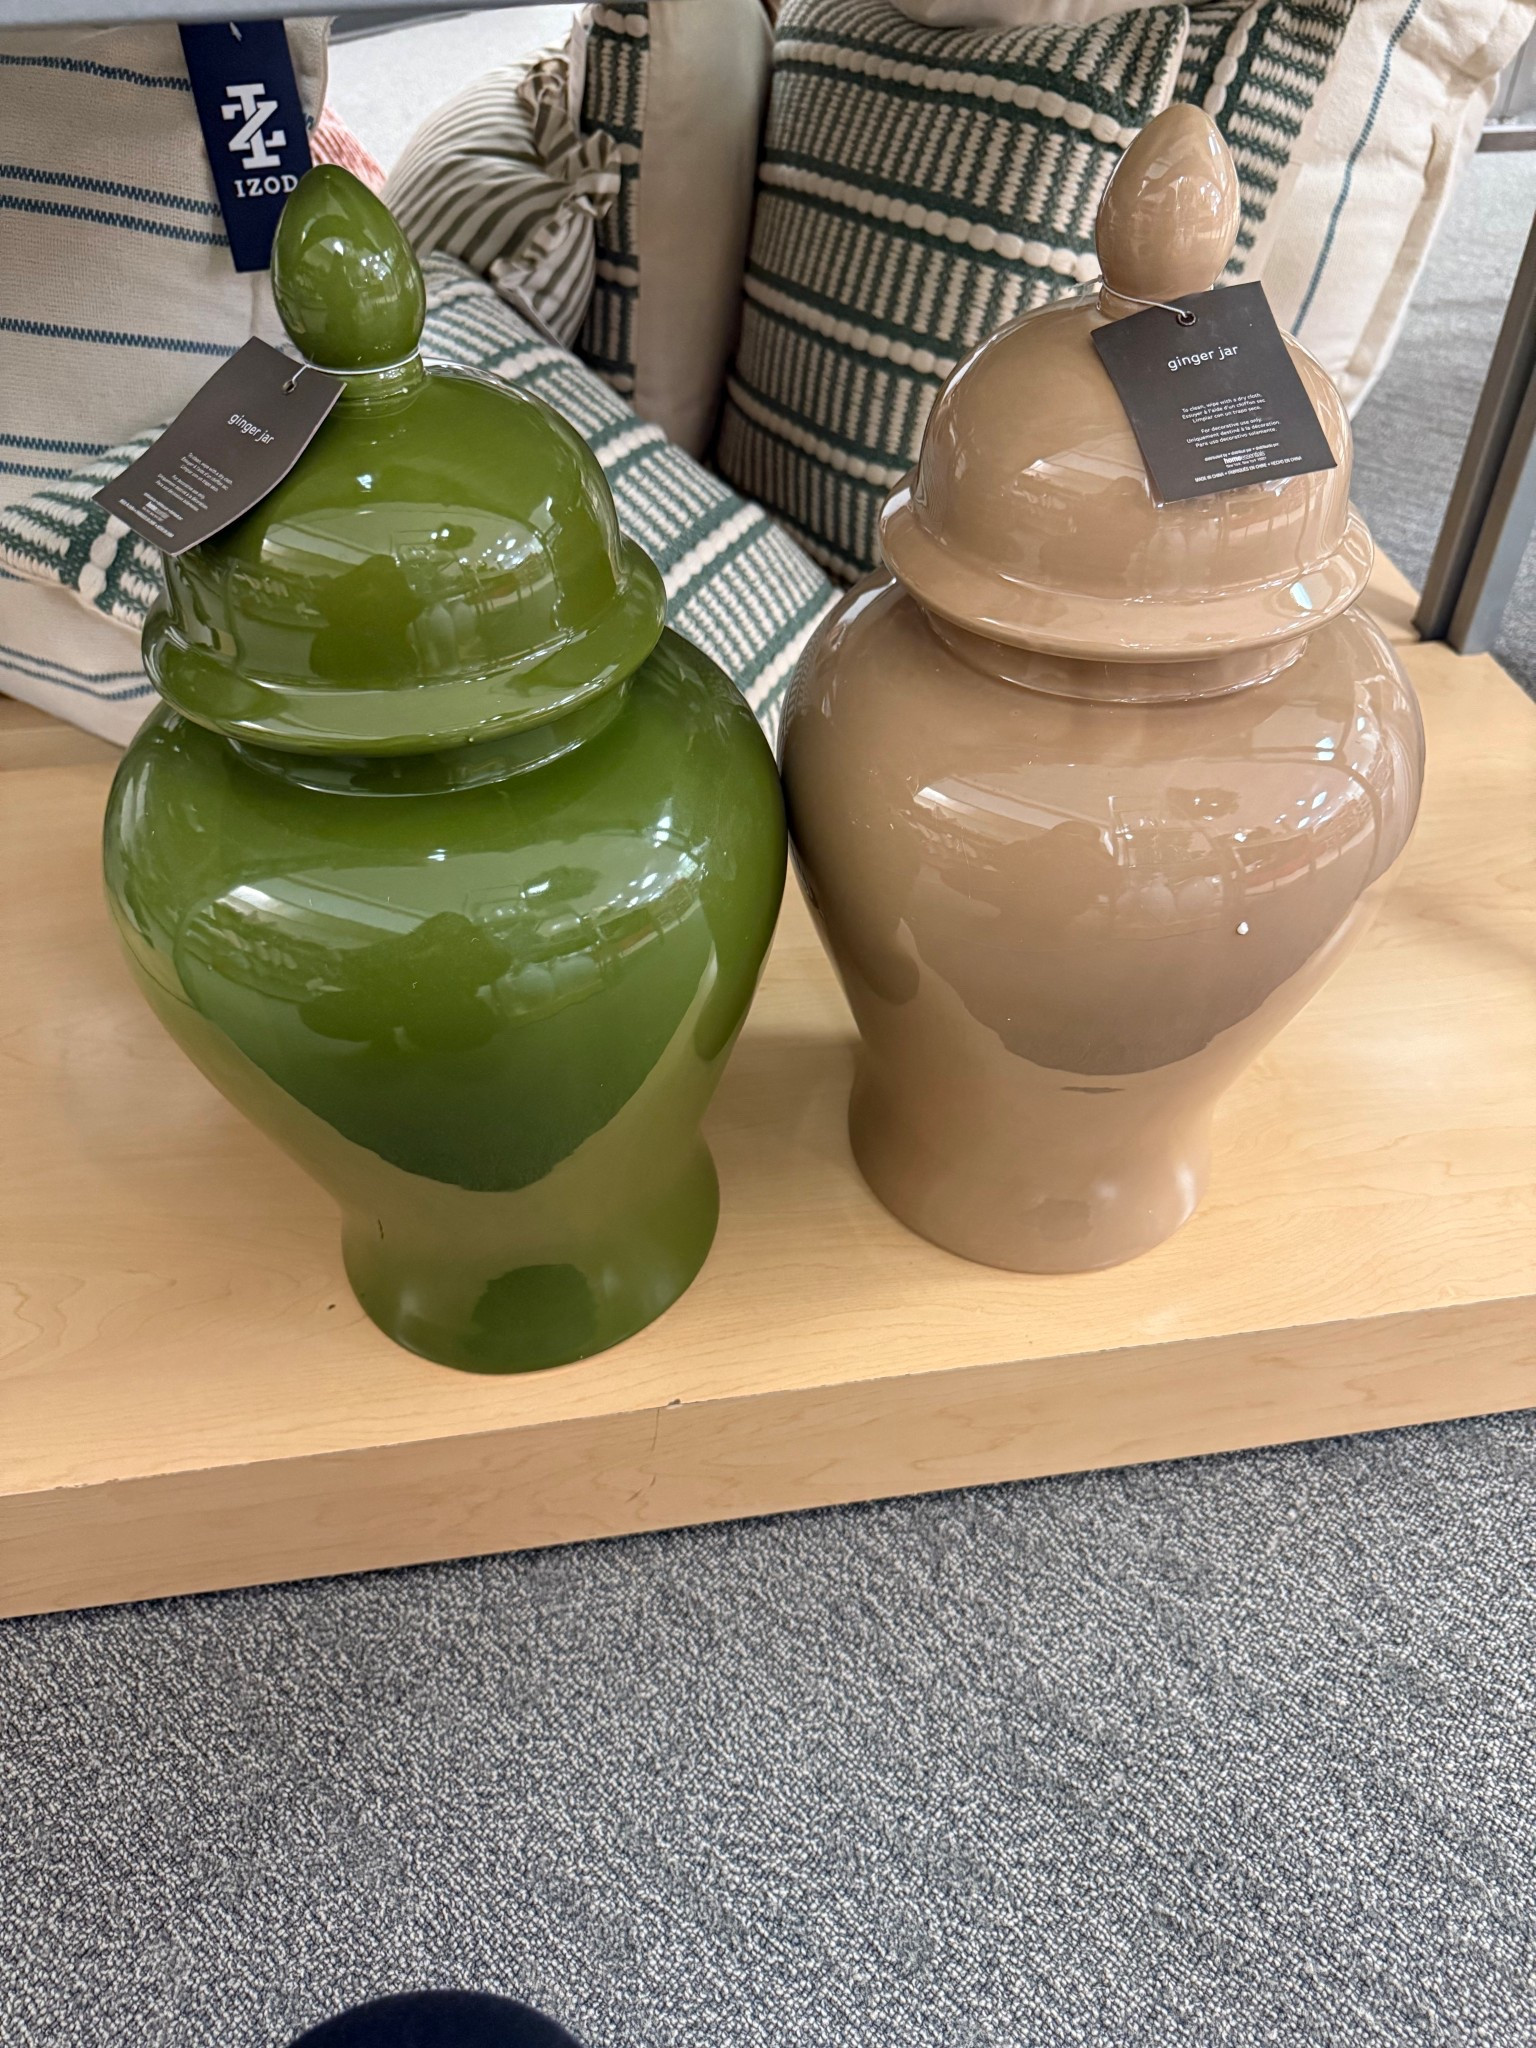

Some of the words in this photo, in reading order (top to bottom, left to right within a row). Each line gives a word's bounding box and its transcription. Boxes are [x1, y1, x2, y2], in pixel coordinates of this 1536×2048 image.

[233, 174, 299, 198] IZOD
[1167, 350, 1214, 372] ginger
[1217, 346, 1238, 361] jar
[227, 414, 262, 437] ginger
[254, 429, 275, 445] jar
[1186, 431, 1219, 443] Uniquement
[1211, 421, 1240, 431] decorative
